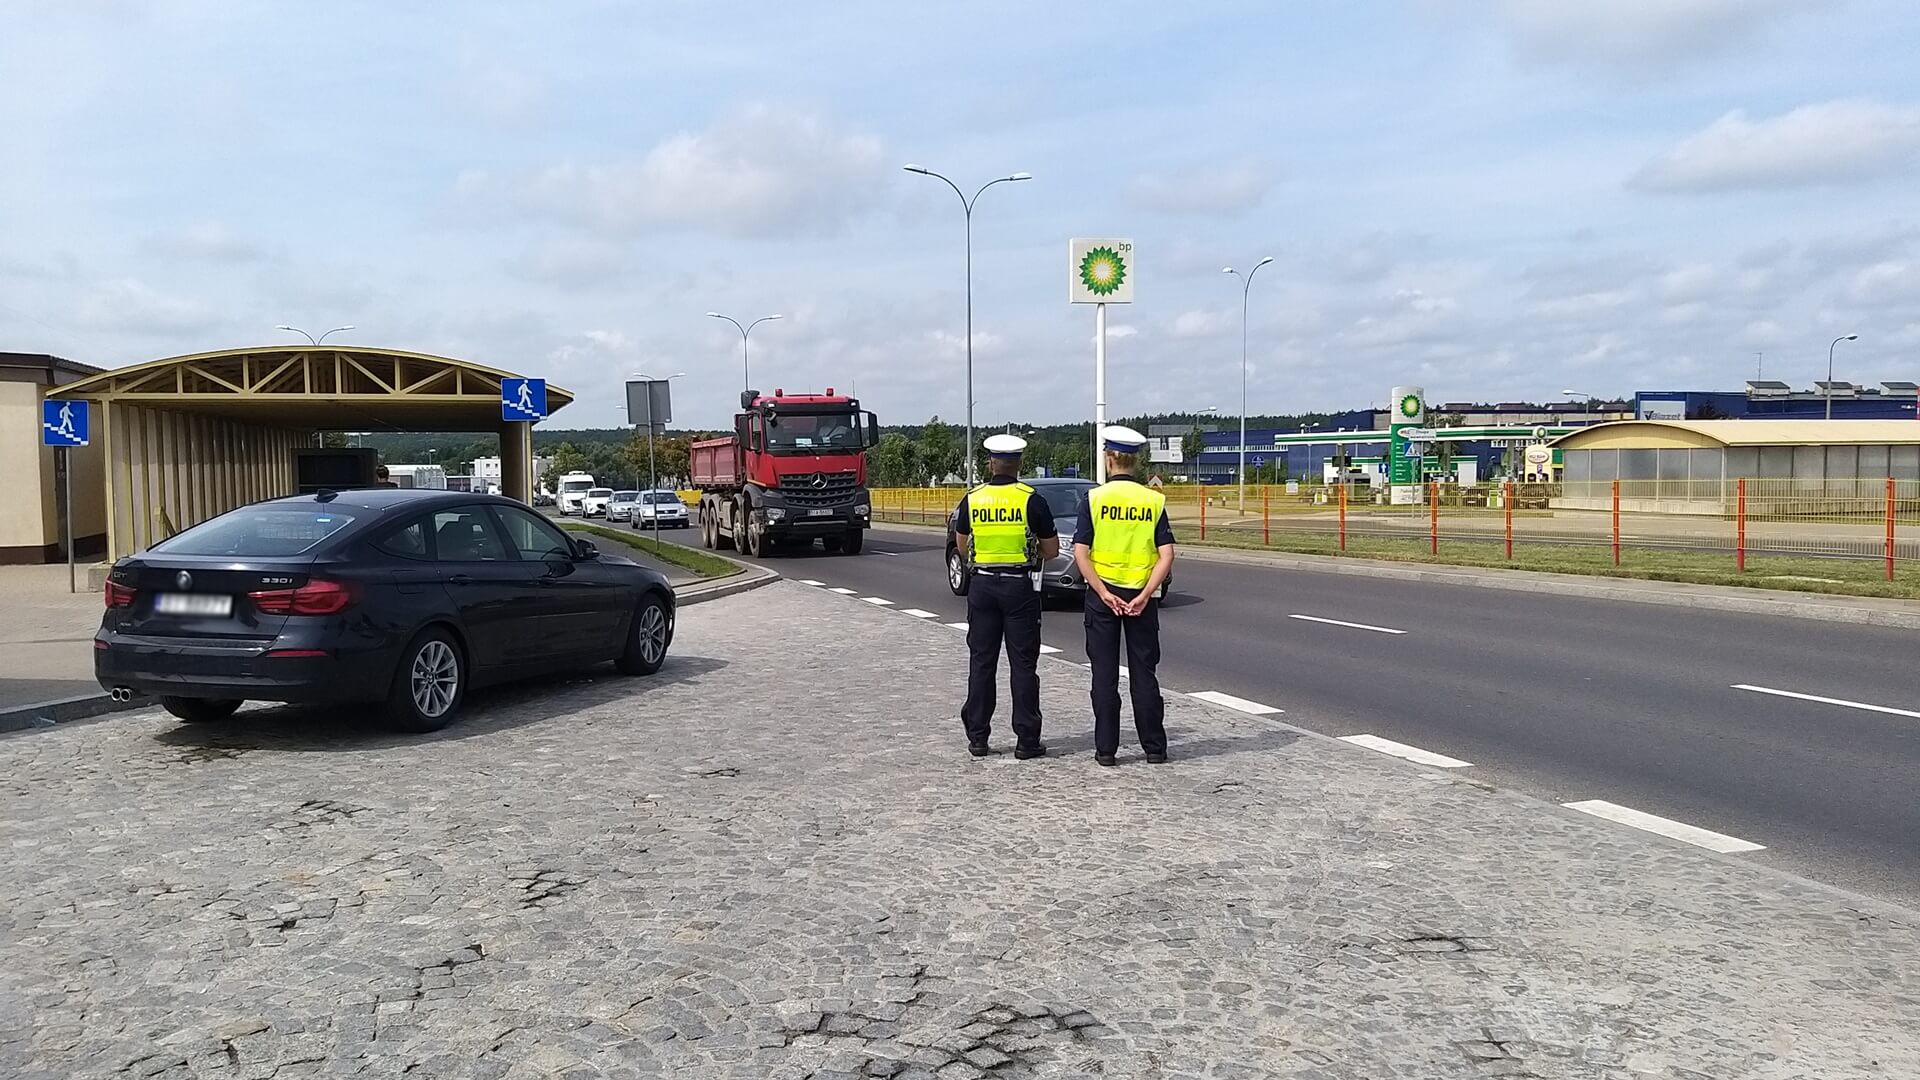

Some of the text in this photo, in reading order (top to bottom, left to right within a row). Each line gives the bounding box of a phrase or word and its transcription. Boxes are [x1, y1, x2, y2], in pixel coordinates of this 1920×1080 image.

[1118, 242, 1132, 253] bp
[972, 508, 1023, 523] POLICJA
[1101, 505, 1153, 522] POLICJA
